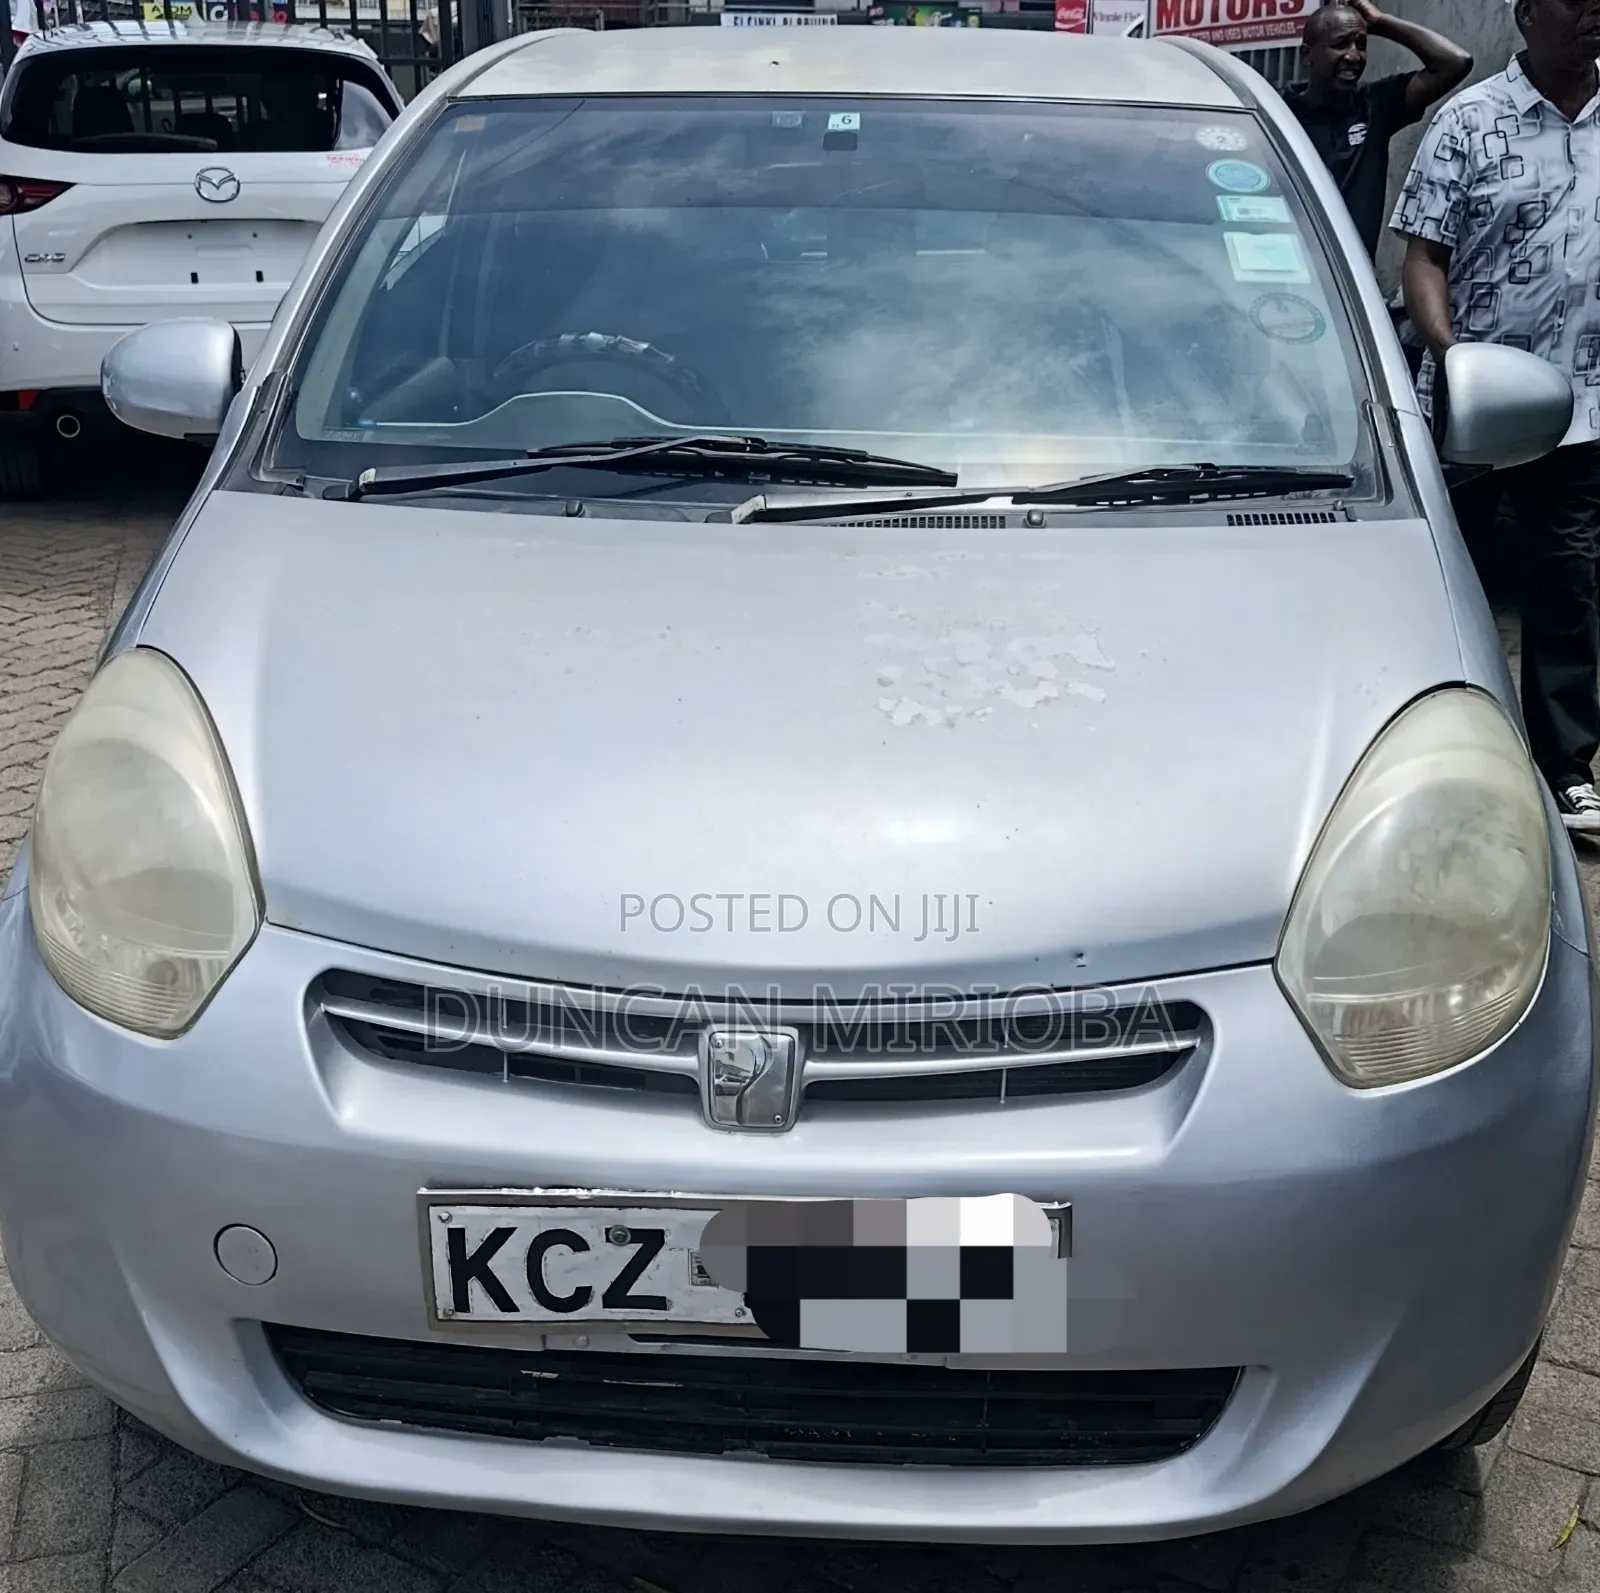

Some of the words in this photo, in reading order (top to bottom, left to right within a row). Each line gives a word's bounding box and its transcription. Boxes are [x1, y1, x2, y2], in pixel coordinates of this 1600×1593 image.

[150, 5, 193, 14] AOM
[1266, 21, 1297, 36] VEHICLES
[841, 115, 852, 125] 6
[447, 1226, 668, 1314] KCZ
